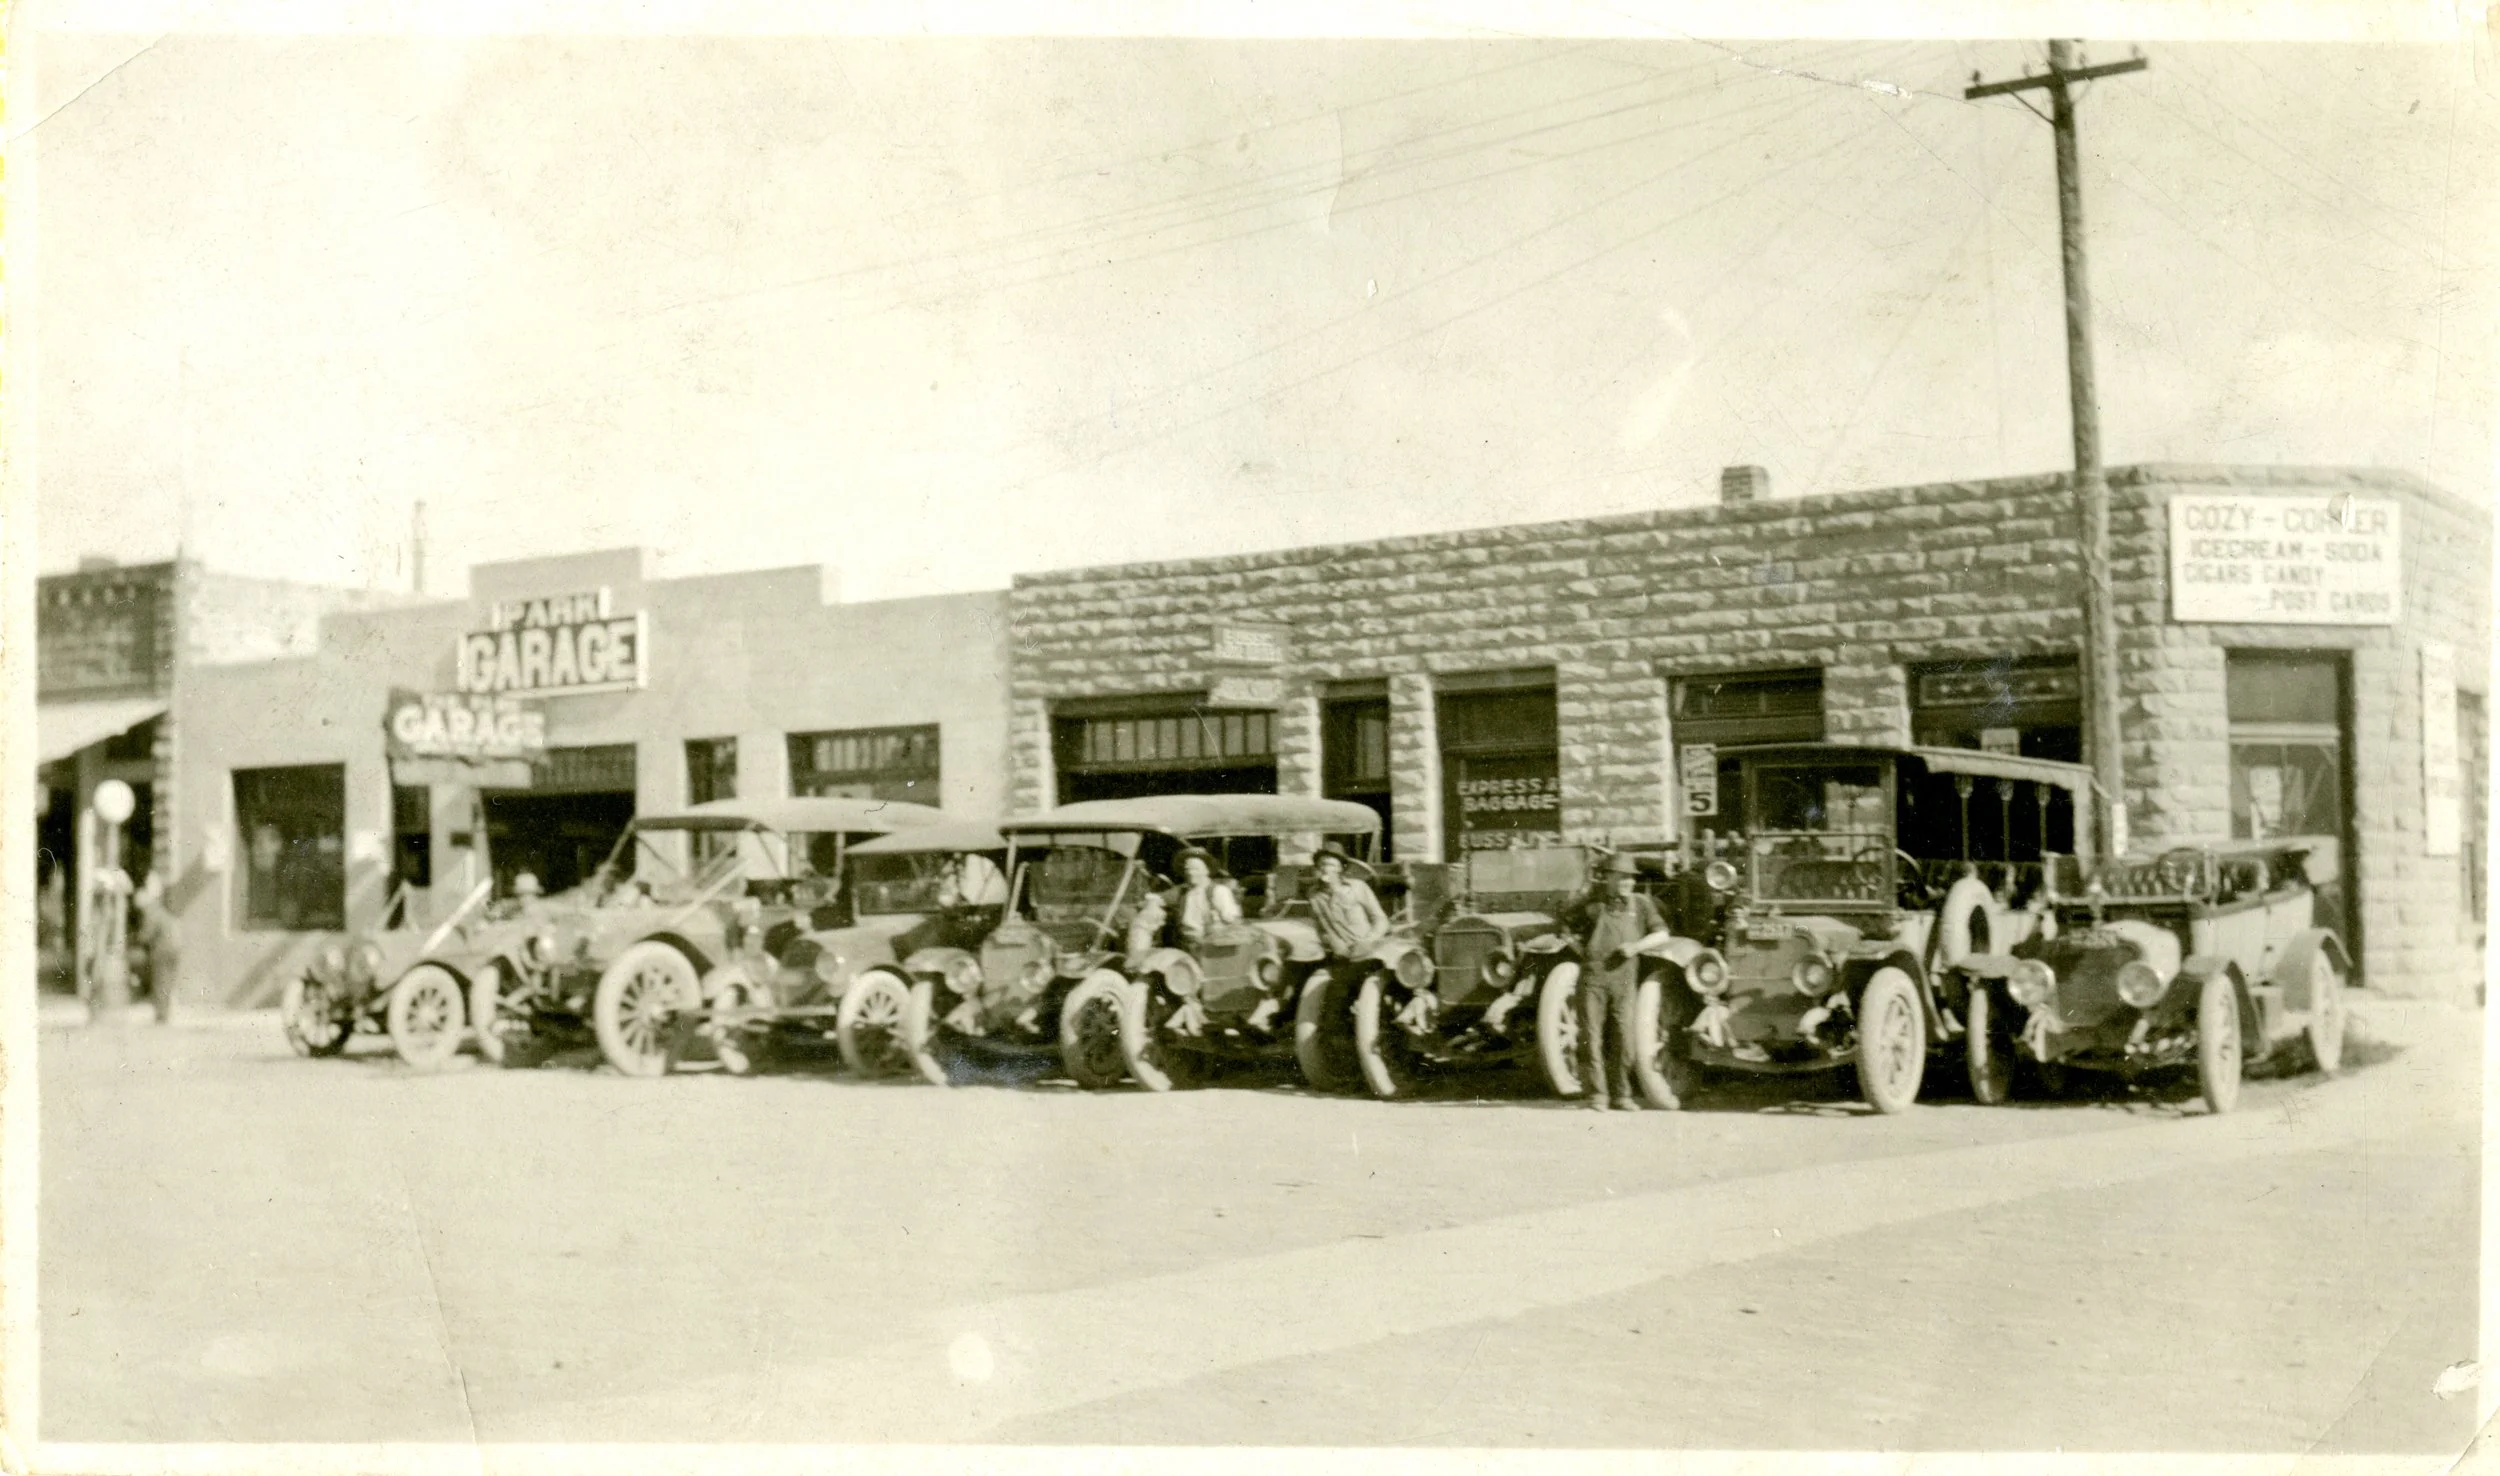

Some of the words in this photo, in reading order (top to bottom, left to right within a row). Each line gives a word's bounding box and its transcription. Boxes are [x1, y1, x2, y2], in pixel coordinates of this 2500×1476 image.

[2186, 505, 2254, 531] COZY
[2284, 507, 2388, 534] CORER
[2324, 542, 2382, 562] SODA
[2184, 563, 2252, 583] CIGARS
[2263, 565, 2324, 585] CANDY
[2269, 588, 2317, 610] POST
[467, 621, 636, 693] GARAGE
[394, 704, 545, 748] GARAGE
[1458, 778, 1542, 795] EXPRESS
[1463, 794, 1559, 811] BAGGAGE
[1690, 792, 1711, 812] 5
